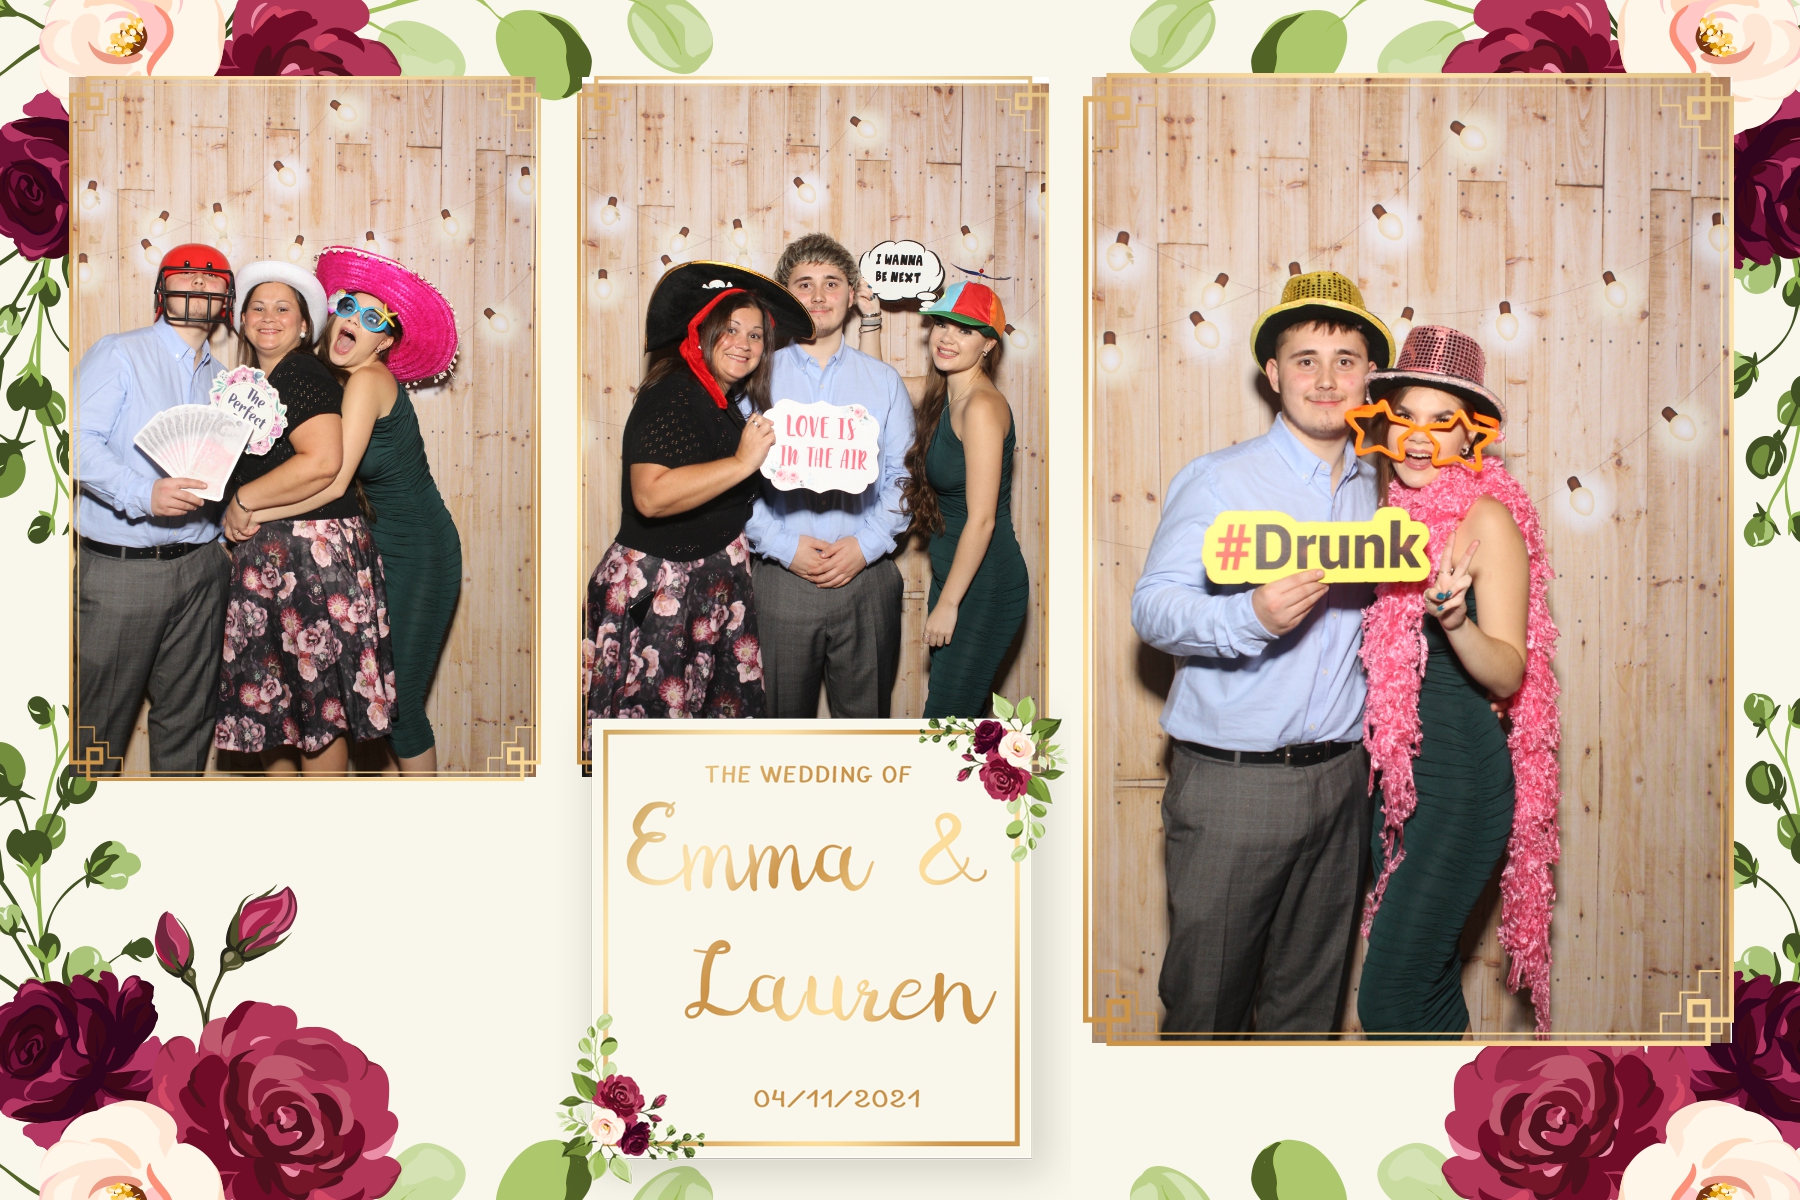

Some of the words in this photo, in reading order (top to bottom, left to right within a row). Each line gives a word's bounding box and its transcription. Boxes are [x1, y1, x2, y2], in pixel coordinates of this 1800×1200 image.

[876, 253, 882, 265] I
[885, 253, 923, 267] WANNA
[876, 270, 888, 282] BE
[890, 271, 922, 284] NEXT
[247, 387, 266, 408] The
[227, 392, 266, 430] Perfect
[786, 414, 830, 438] LOVE
[838, 417, 856, 440] IS
[807, 446, 834, 468] THE
[840, 449, 867, 471] AIR
[1215, 520, 1422, 571] #Drunk
